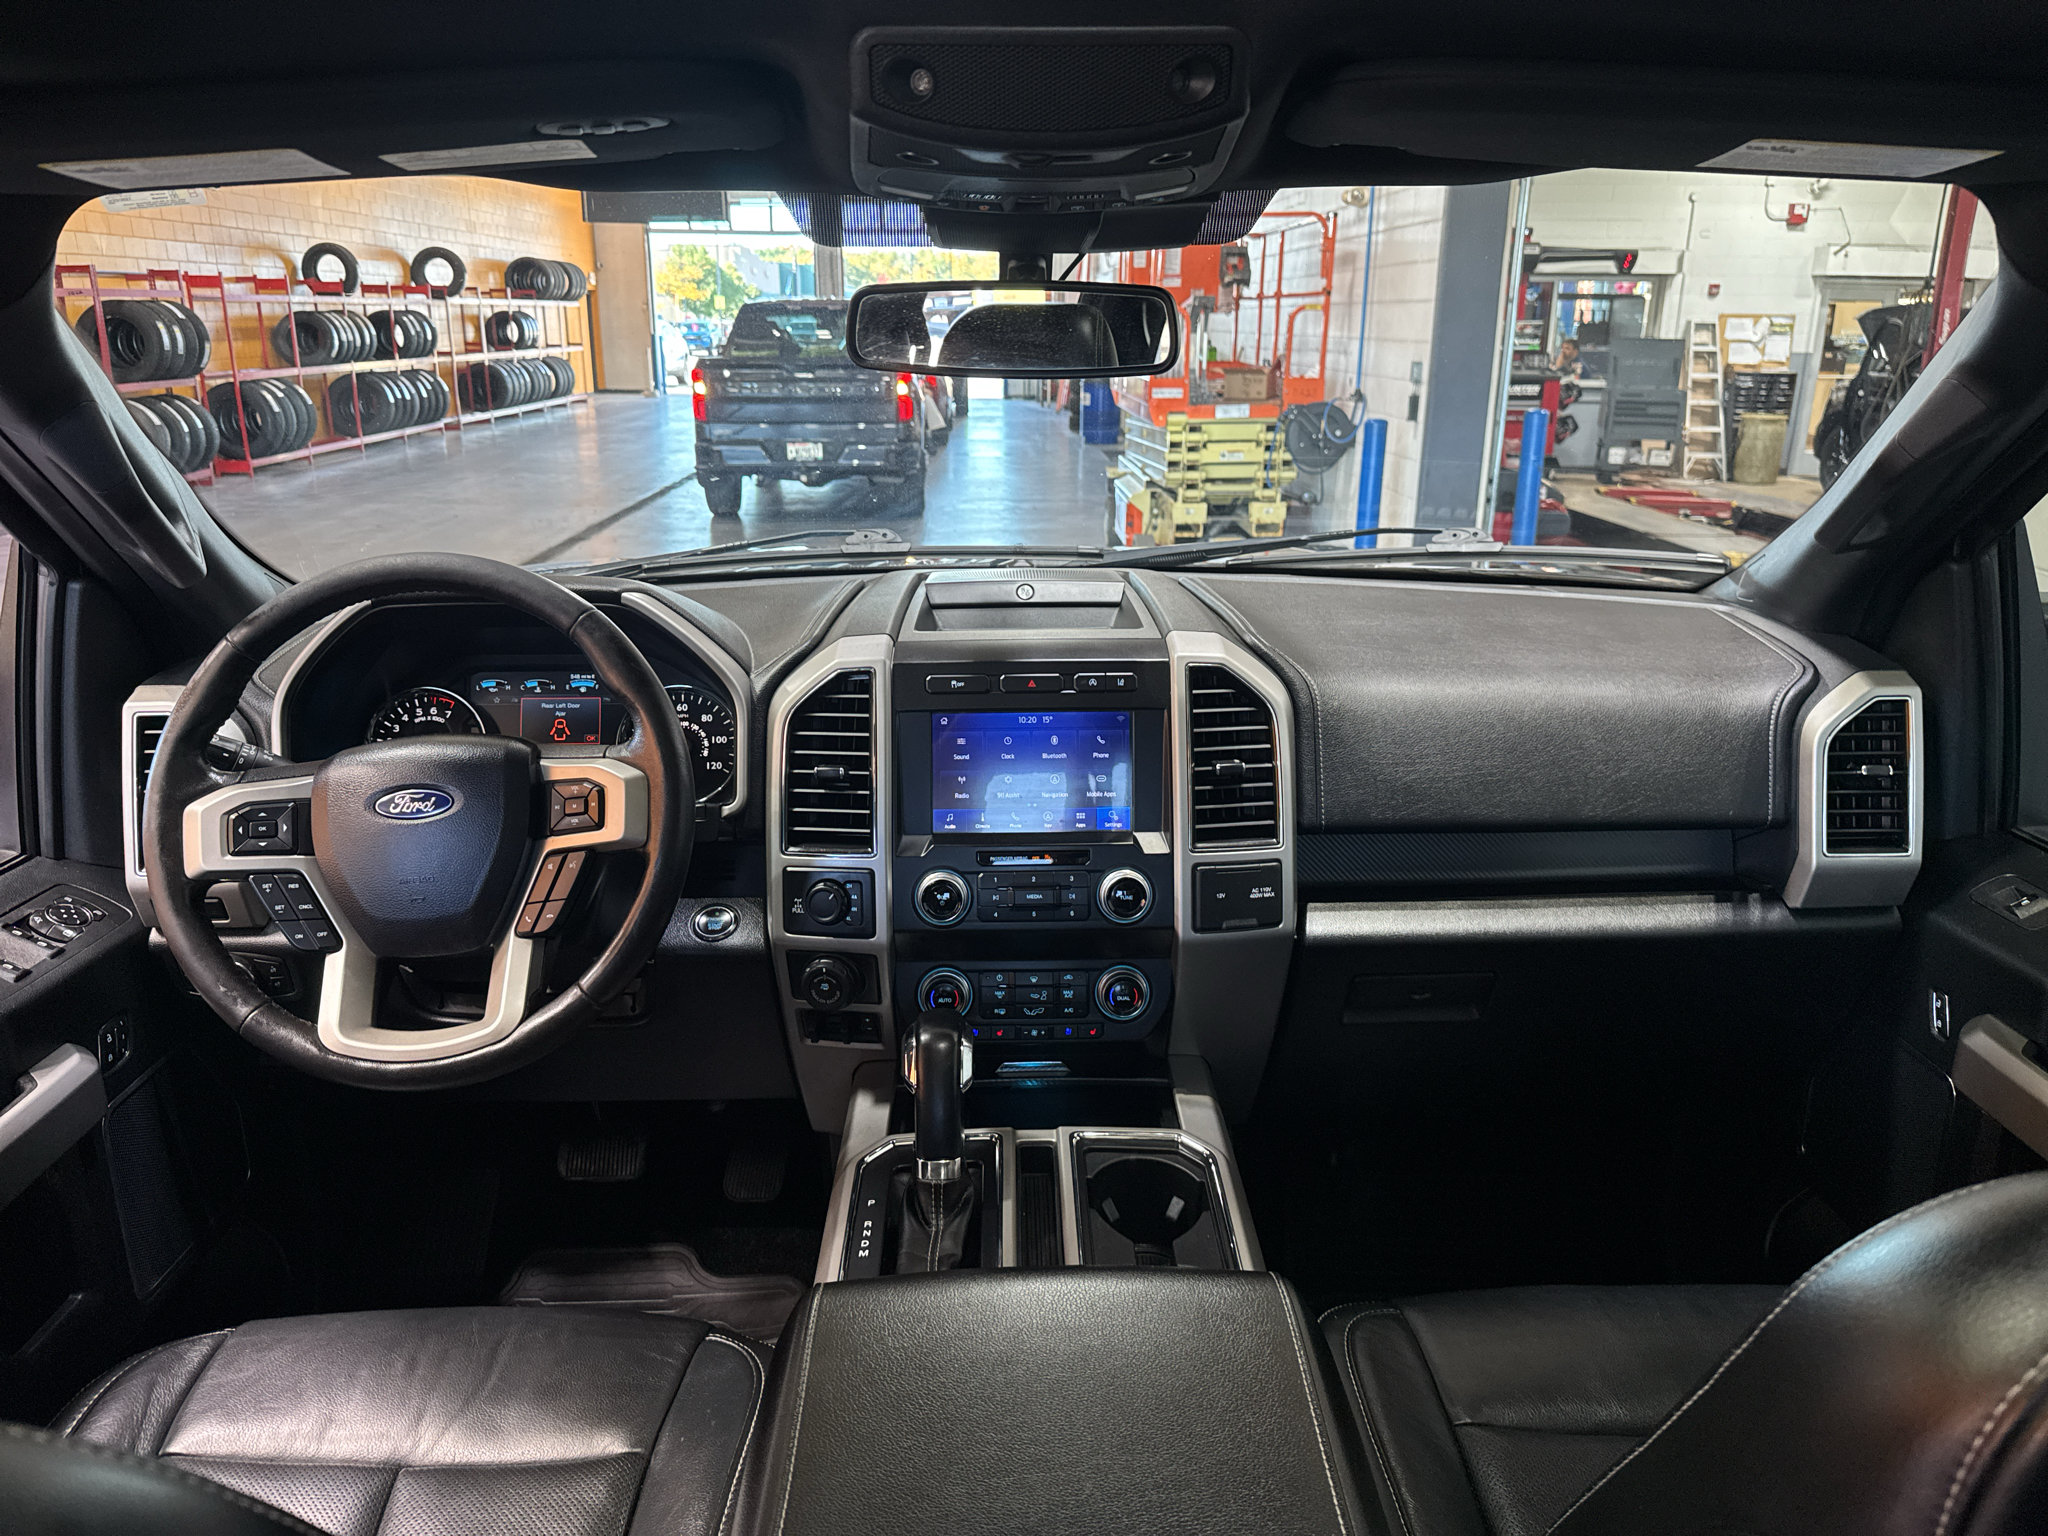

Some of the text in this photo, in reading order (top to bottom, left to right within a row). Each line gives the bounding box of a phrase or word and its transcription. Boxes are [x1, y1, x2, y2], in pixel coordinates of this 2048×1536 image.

[416, 708, 422, 716] 5
[430, 707, 437, 715] 6
[445, 711, 452, 719] 7
[402, 714, 409, 722] 4
[701, 714, 712, 722] 80
[1018, 716, 1053, 724] 10:20 15°
[393, 724, 399, 732] 3
[711, 736, 727, 744] 100
[706, 762, 722, 770] 120
[389, 791, 436, 814] Ford
[867, 1199, 876, 1207] P
[864, 1220, 872, 1228] R
